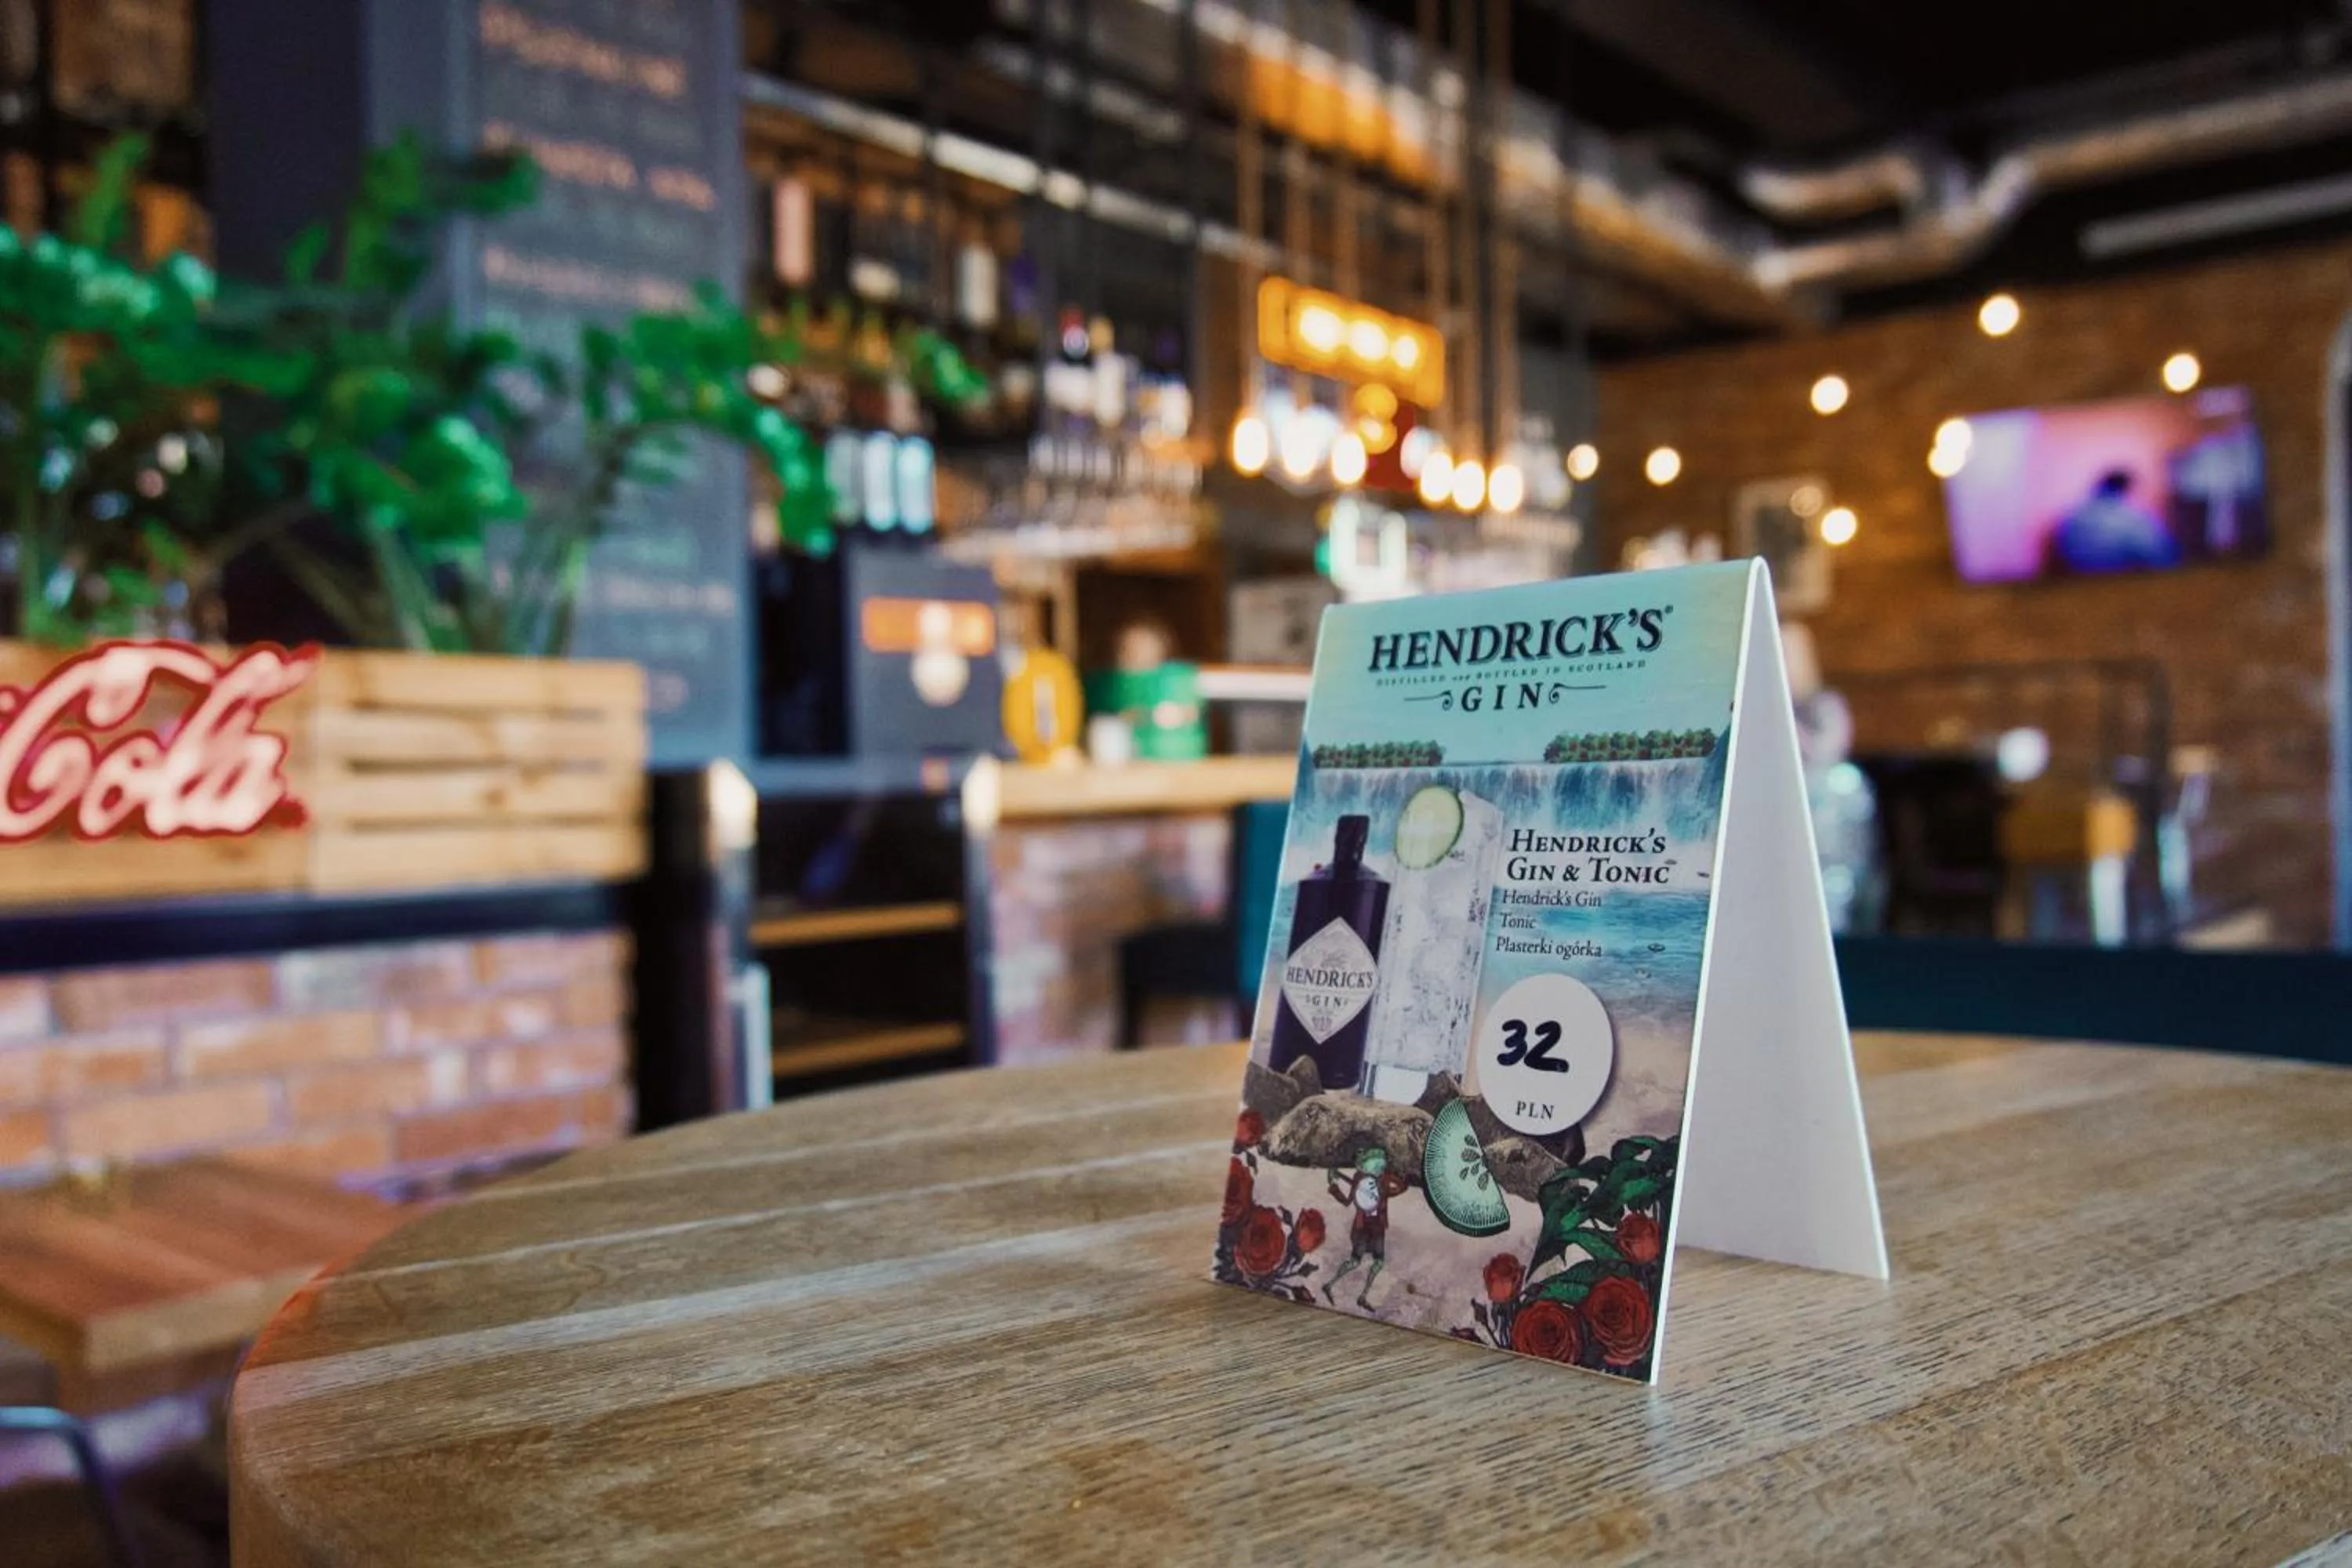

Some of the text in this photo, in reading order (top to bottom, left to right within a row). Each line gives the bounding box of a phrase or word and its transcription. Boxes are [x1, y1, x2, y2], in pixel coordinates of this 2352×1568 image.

[1367, 608, 1665, 673] HENDRICK'S
[1461, 682, 1544, 712] GIN
[0, 641, 323, 842] Cola
[1562, 865, 1580, 883] &
[1501, 890, 1602, 908] Hendrick's Gin
[1500, 912, 1537, 930] Tonic
[1495, 935, 1602, 960] Plasterki ogórka
[1312, 995, 1342, 1007] GIN
[1497, 1018, 1570, 1073] 32
[1515, 1100, 1555, 1120] PLN
